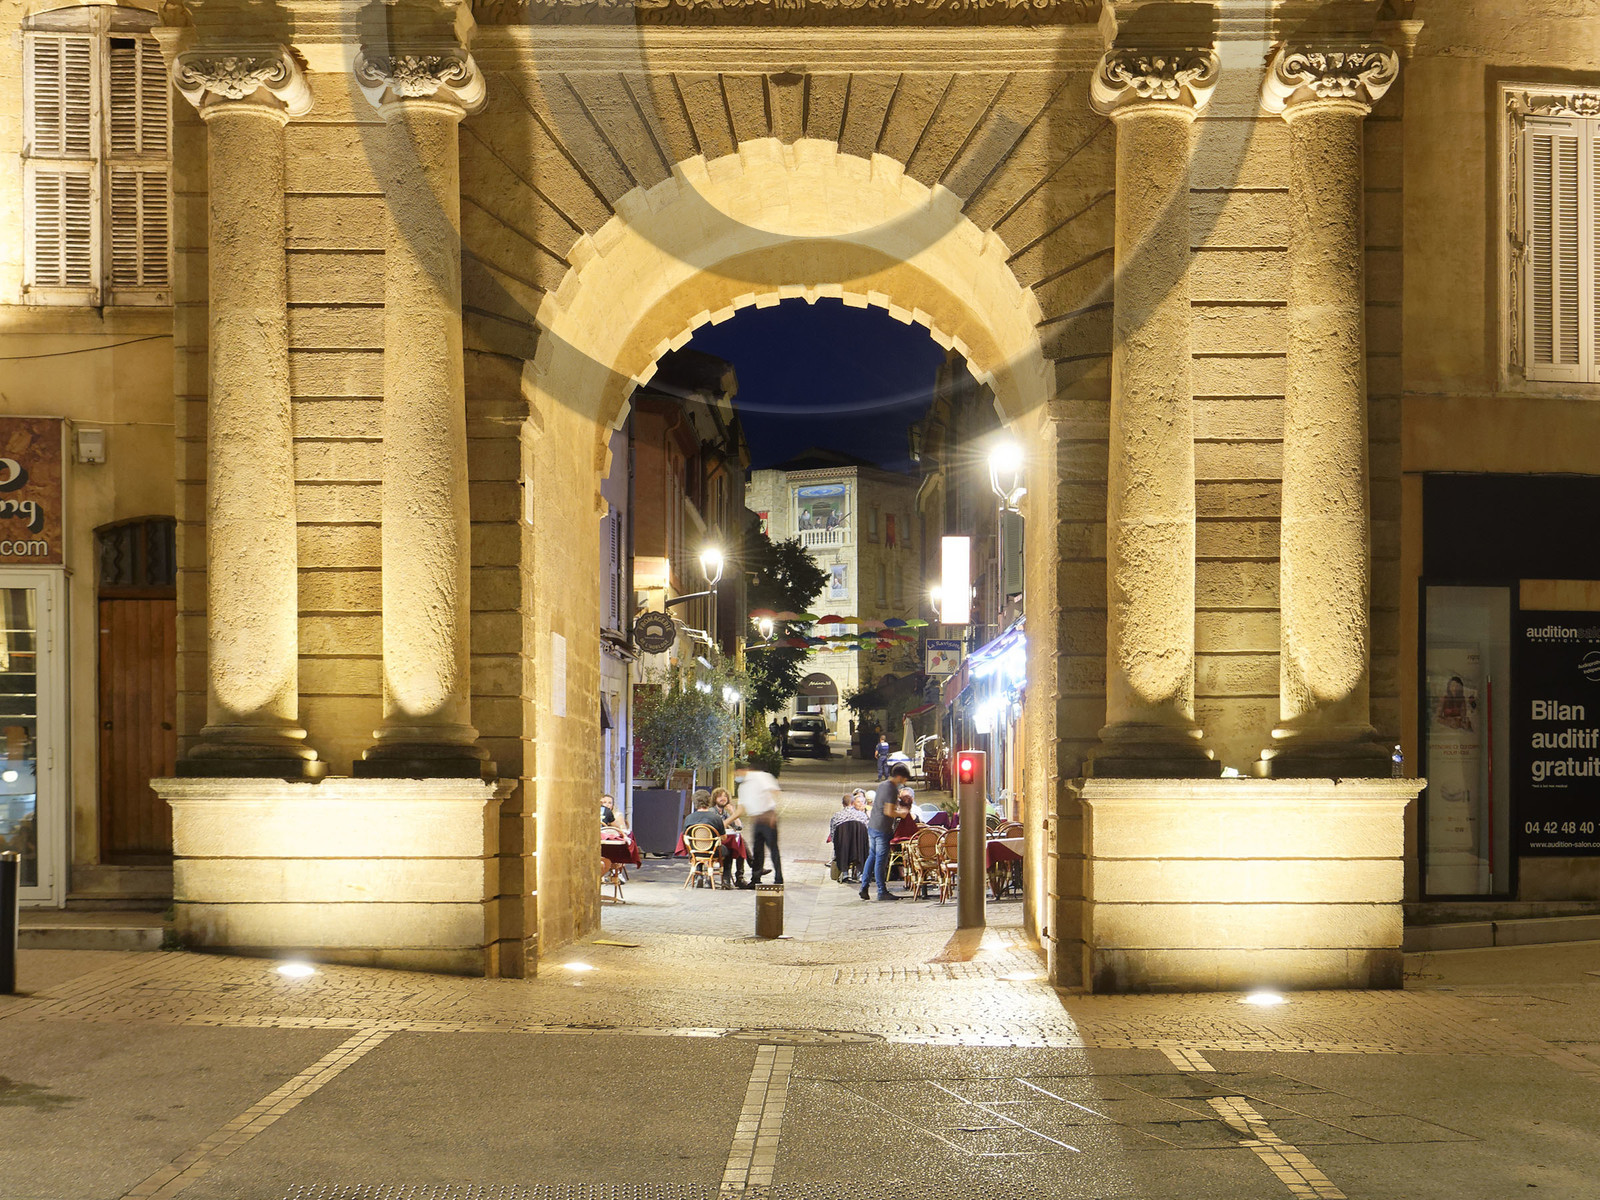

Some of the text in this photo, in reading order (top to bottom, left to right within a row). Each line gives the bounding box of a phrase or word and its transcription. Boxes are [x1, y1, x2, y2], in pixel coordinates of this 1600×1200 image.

[1531, 700, 1585, 721] Bilan
[1531, 728, 1599, 749] auditif
[1531, 756, 1600, 782] gratuit
[1525, 821, 1595, 834] 04 42 48 40
